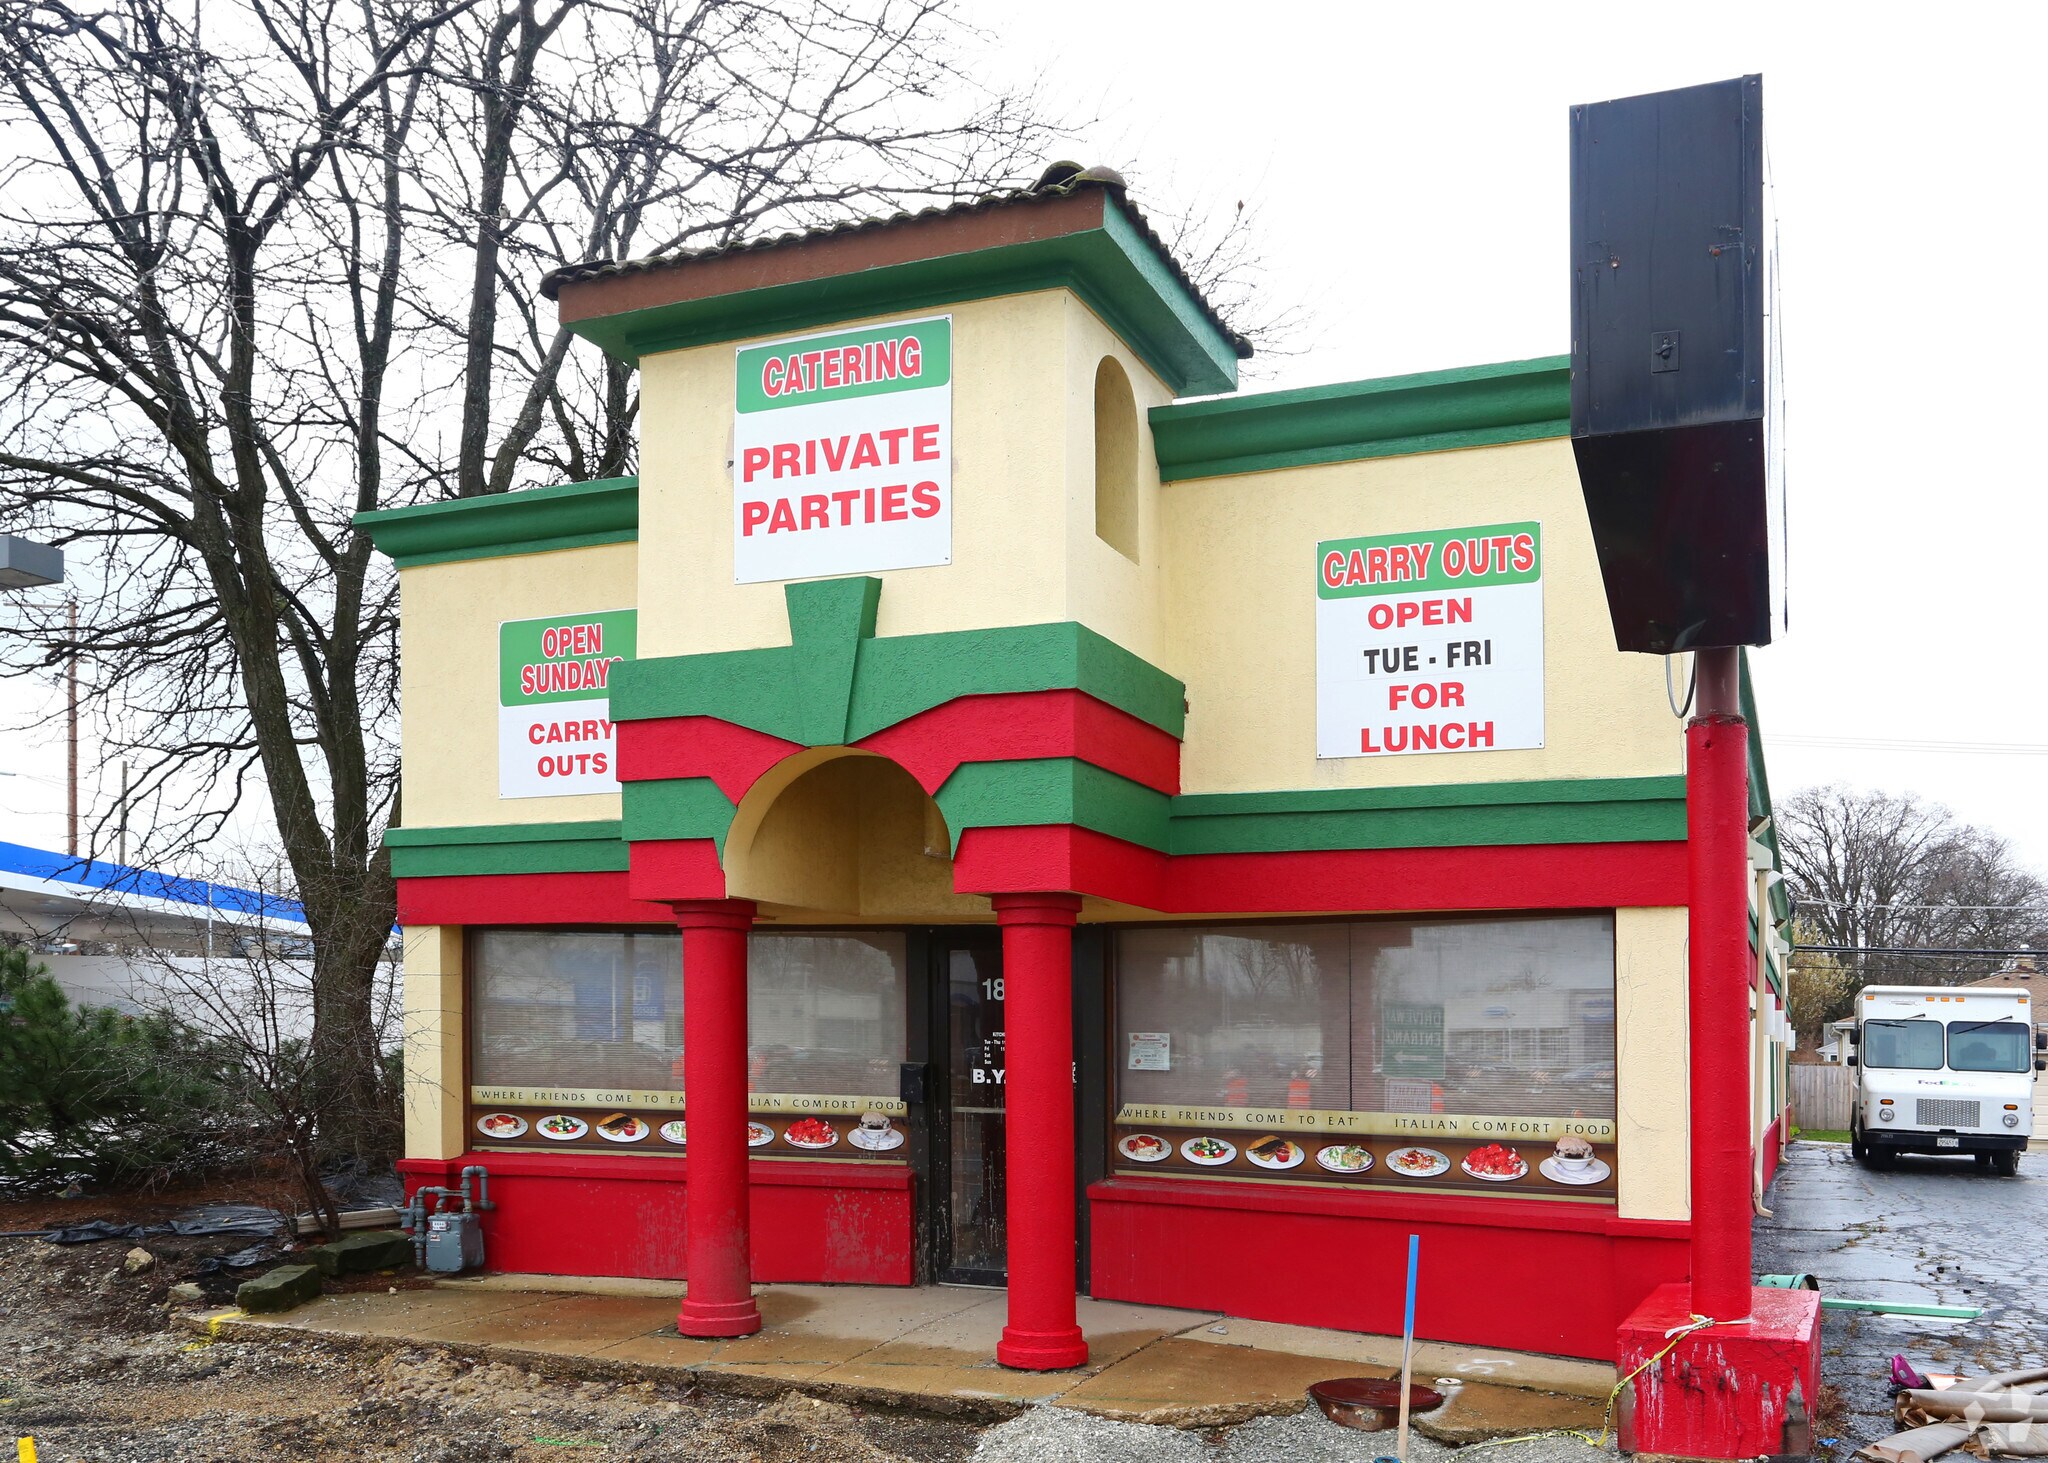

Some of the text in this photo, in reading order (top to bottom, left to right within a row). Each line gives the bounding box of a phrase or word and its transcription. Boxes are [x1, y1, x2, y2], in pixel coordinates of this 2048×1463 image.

[762, 336, 922, 397] CATERING
[743, 424, 940, 483] PRIVATE
[743, 481, 941, 537] PARTIES
[1323, 533, 1534, 587] CARRY OUTS
[1368, 597, 1472, 629] OPEN
[542, 623, 603, 658] OPEN
[1364, 645, 1419, 674] TUE
[1447, 639, 1491, 668] FRI
[520, 657, 624, 695] SUNDAY
[1389, 682, 1465, 711] FOR
[528, 719, 615, 745] CARRY
[1361, 721, 1494, 753] LUNCH
[537, 752, 608, 778] OUTS
[534, 1091, 586, 1102] FRIENDS
[596, 1093, 633, 1103] COME
[643, 1095, 659, 1104] TO
[670, 1096, 685, 1104] EA
[750, 1098, 781, 1107] LIAN
[792, 1099, 857, 1109] COMFORT
[868, 1101, 905, 1110] FOOD
[1178, 1110, 1234, 1122] FRIENDS
[1245, 1113, 1285, 1124] COME
[1298, 1115, 1316, 1126] TO
[1394, 1118, 1458, 1131] ITALIAN
[1472, 1120, 1550, 1134] COMFORT
[1565, 1124, 1611, 1136] FOOD
